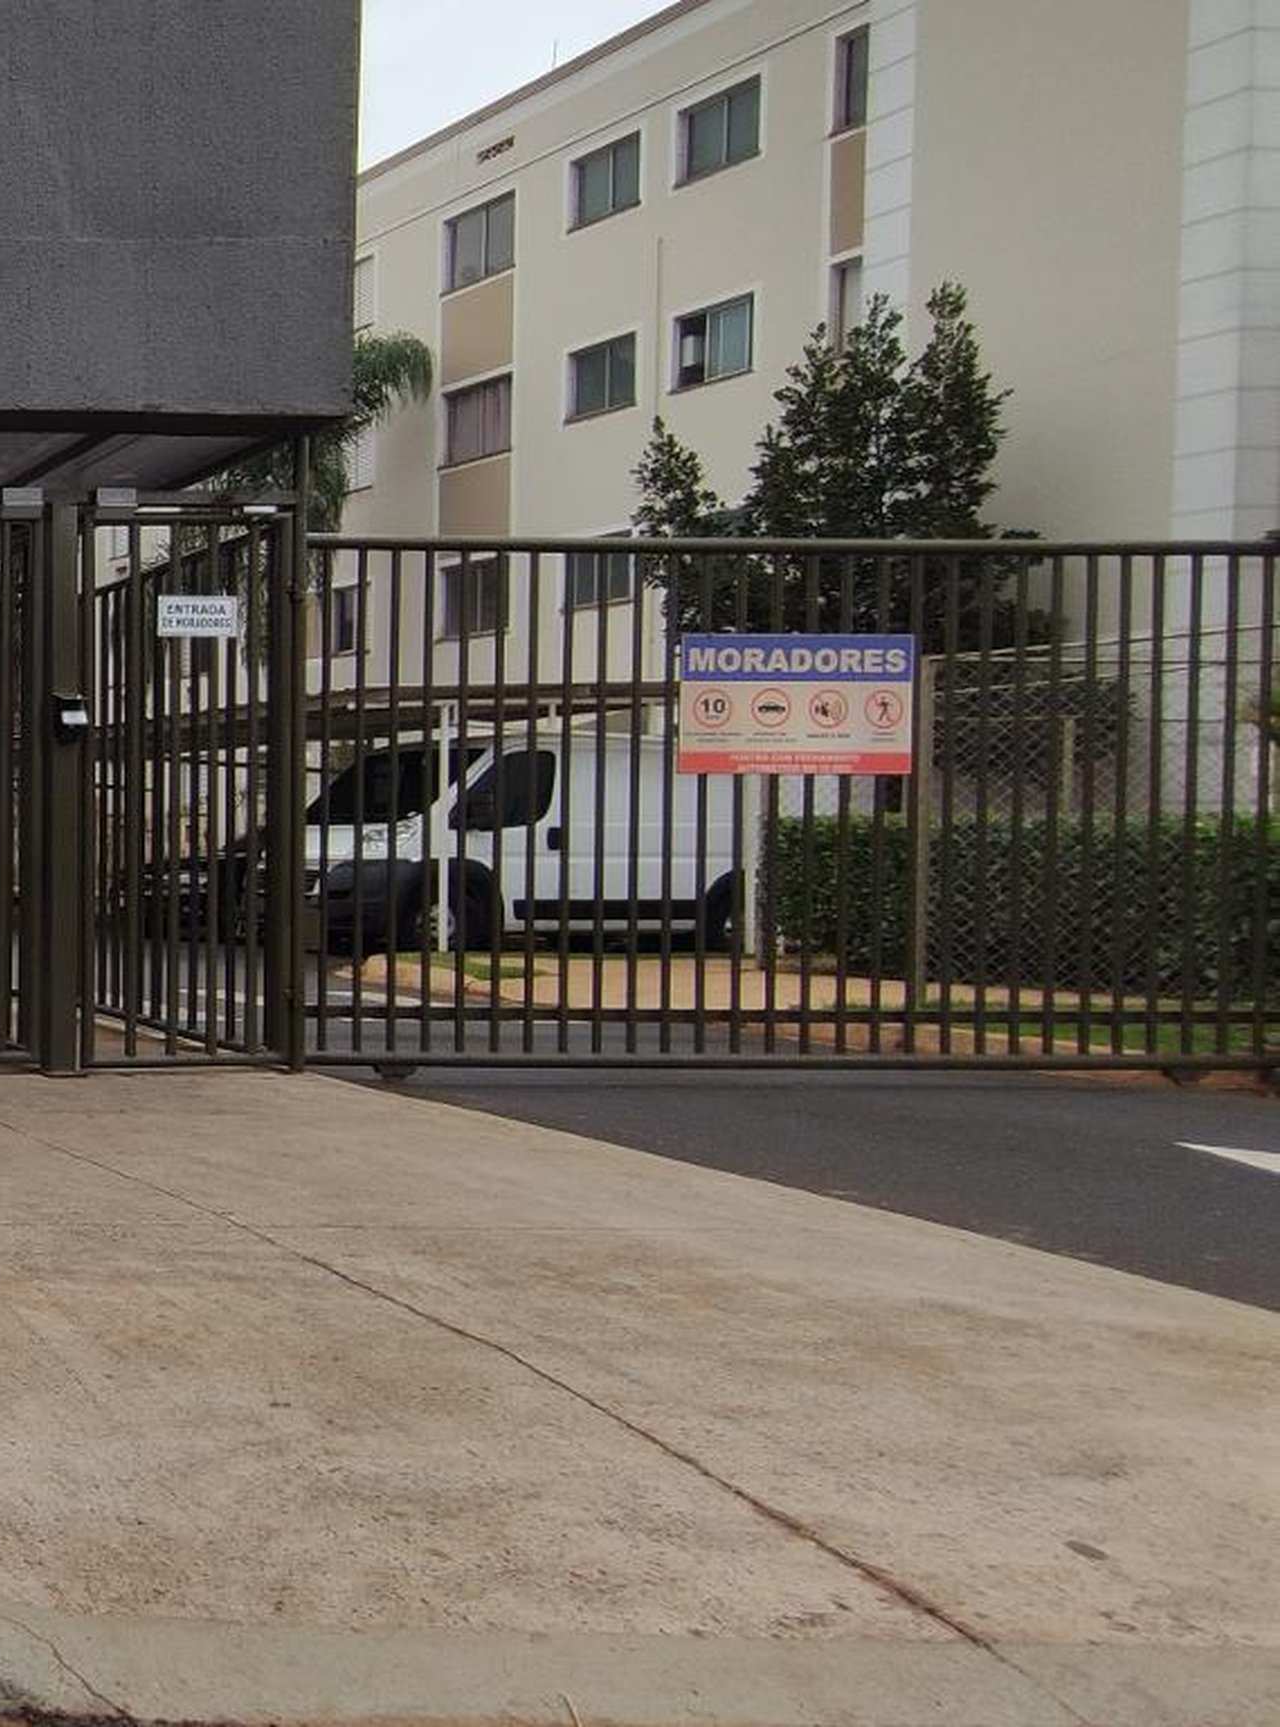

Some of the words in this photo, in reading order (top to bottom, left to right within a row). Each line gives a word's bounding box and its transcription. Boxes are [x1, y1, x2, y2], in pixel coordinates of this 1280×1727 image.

[166, 603, 227, 615] ENTRADA
[689, 647, 907, 674] MORADORES
[700, 698, 726, 714] 10
